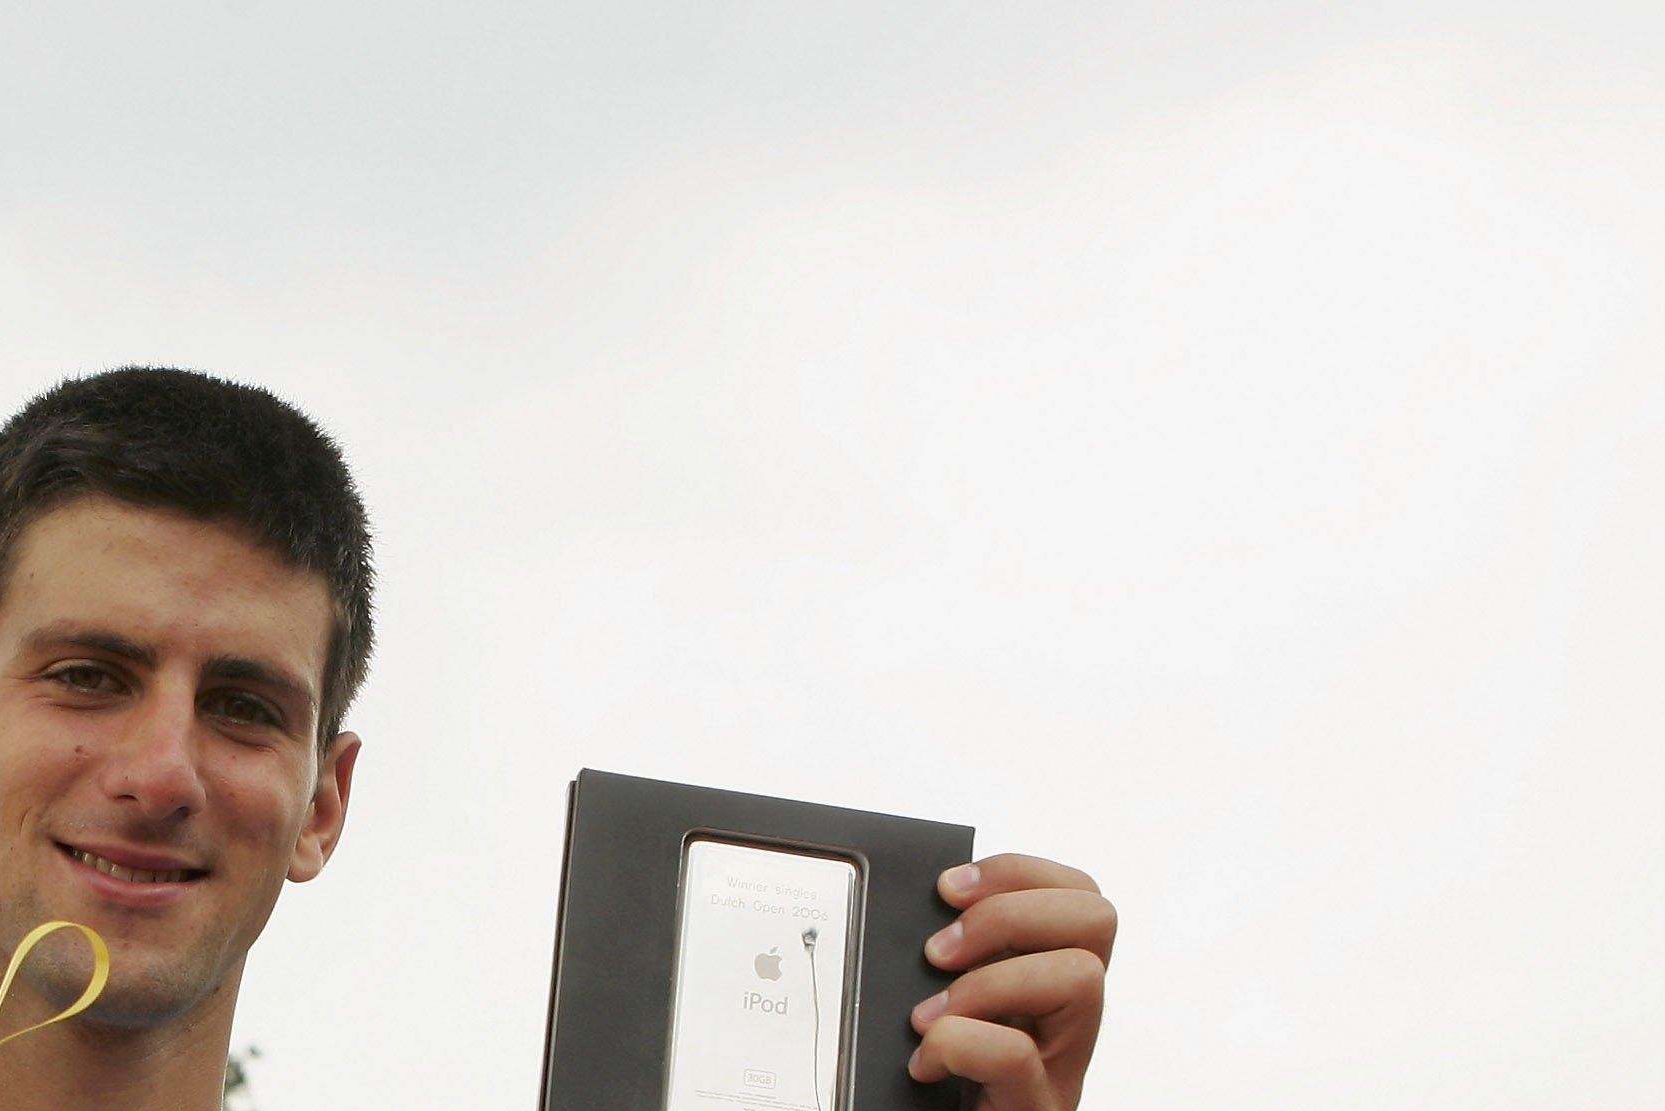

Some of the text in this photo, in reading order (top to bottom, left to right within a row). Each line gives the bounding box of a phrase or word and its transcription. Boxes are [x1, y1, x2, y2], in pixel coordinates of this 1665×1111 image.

[726, 876, 768, 893] Winner
[710, 893, 746, 909] Dutch
[752, 900, 786, 915] Open
[742, 991, 789, 1016] iPod
